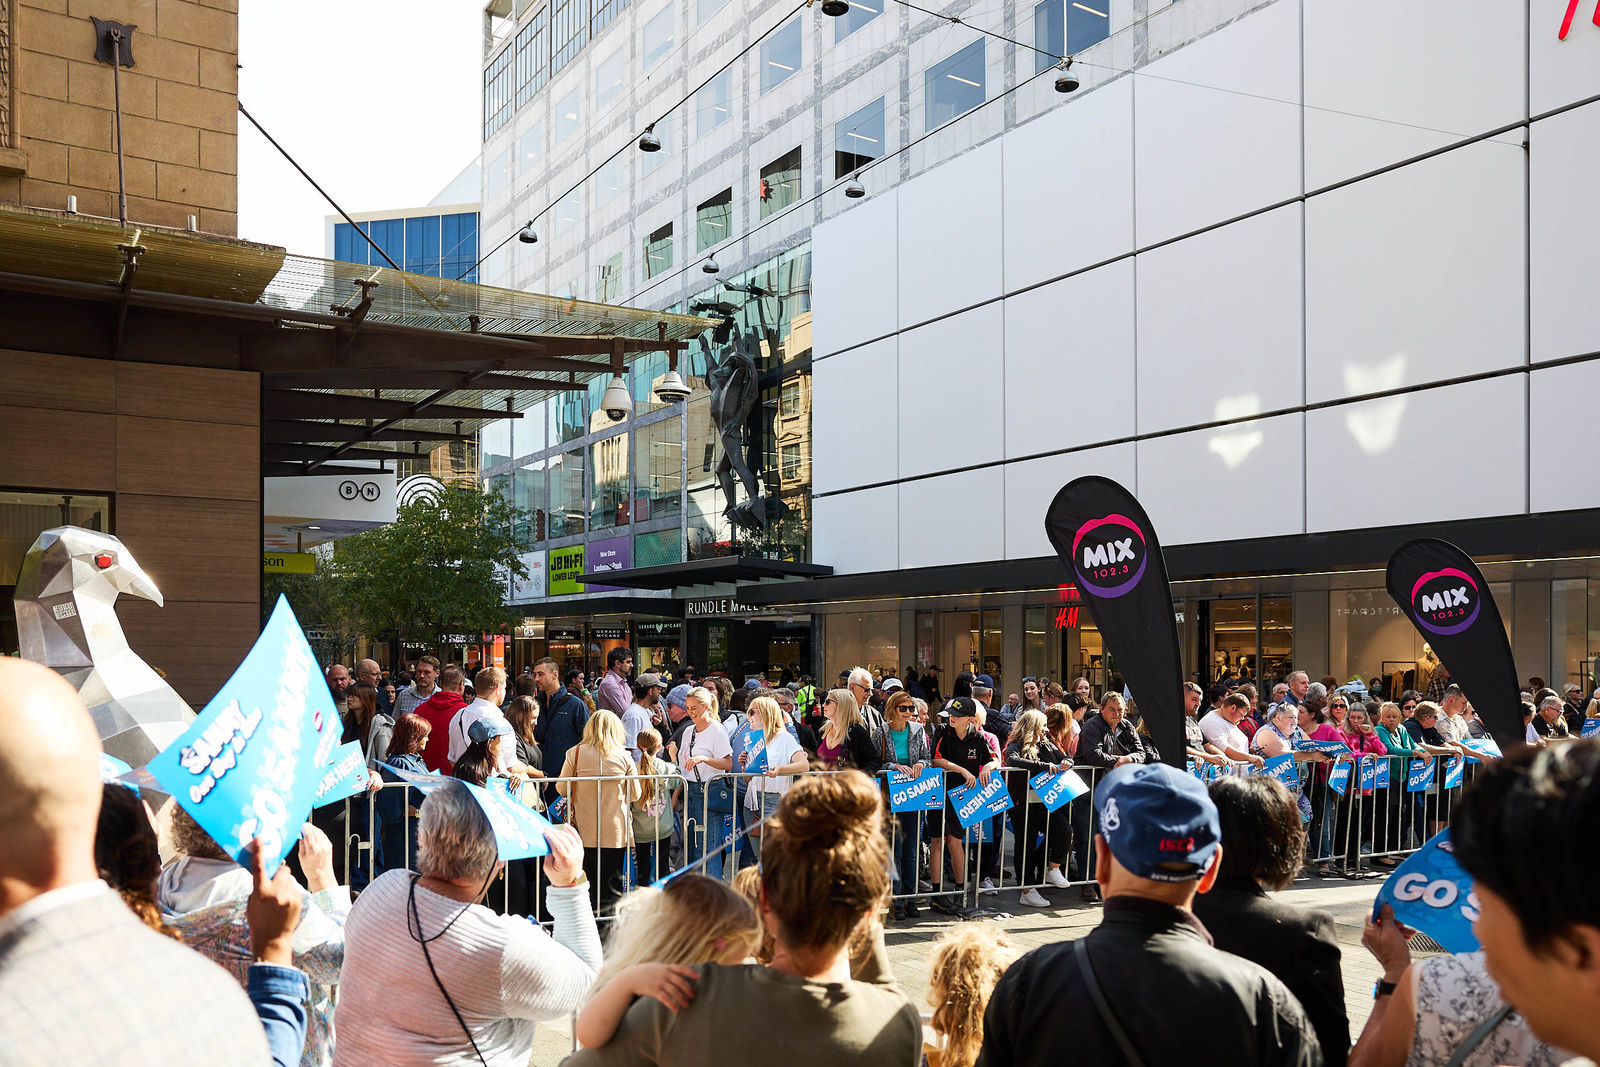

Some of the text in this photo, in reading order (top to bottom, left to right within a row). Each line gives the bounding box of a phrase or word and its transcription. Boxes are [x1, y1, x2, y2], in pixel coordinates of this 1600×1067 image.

[367, 487, 374, 496] N
[551, 555, 562, 571] JB
[563, 552, 583, 569] HI-FI
[1084, 538, 1135, 569] MIX
[552, 572, 567, 582] LOWER
[1093, 564, 1129, 579] 102.3
[688, 600, 727, 615] RUNDLE
[1422, 586, 1470, 613] MIX
[1432, 607, 1465, 621] 102.3
[1267, 759, 1294, 779] AMMY
[893, 790, 908, 806] GO
[906, 774, 941, 799] SAMMY
[981, 778, 1002, 799] OUR
[1044, 790, 1059, 805] GO
[959, 793, 986, 819] HERO
[1393, 872, 1459, 908] GO
